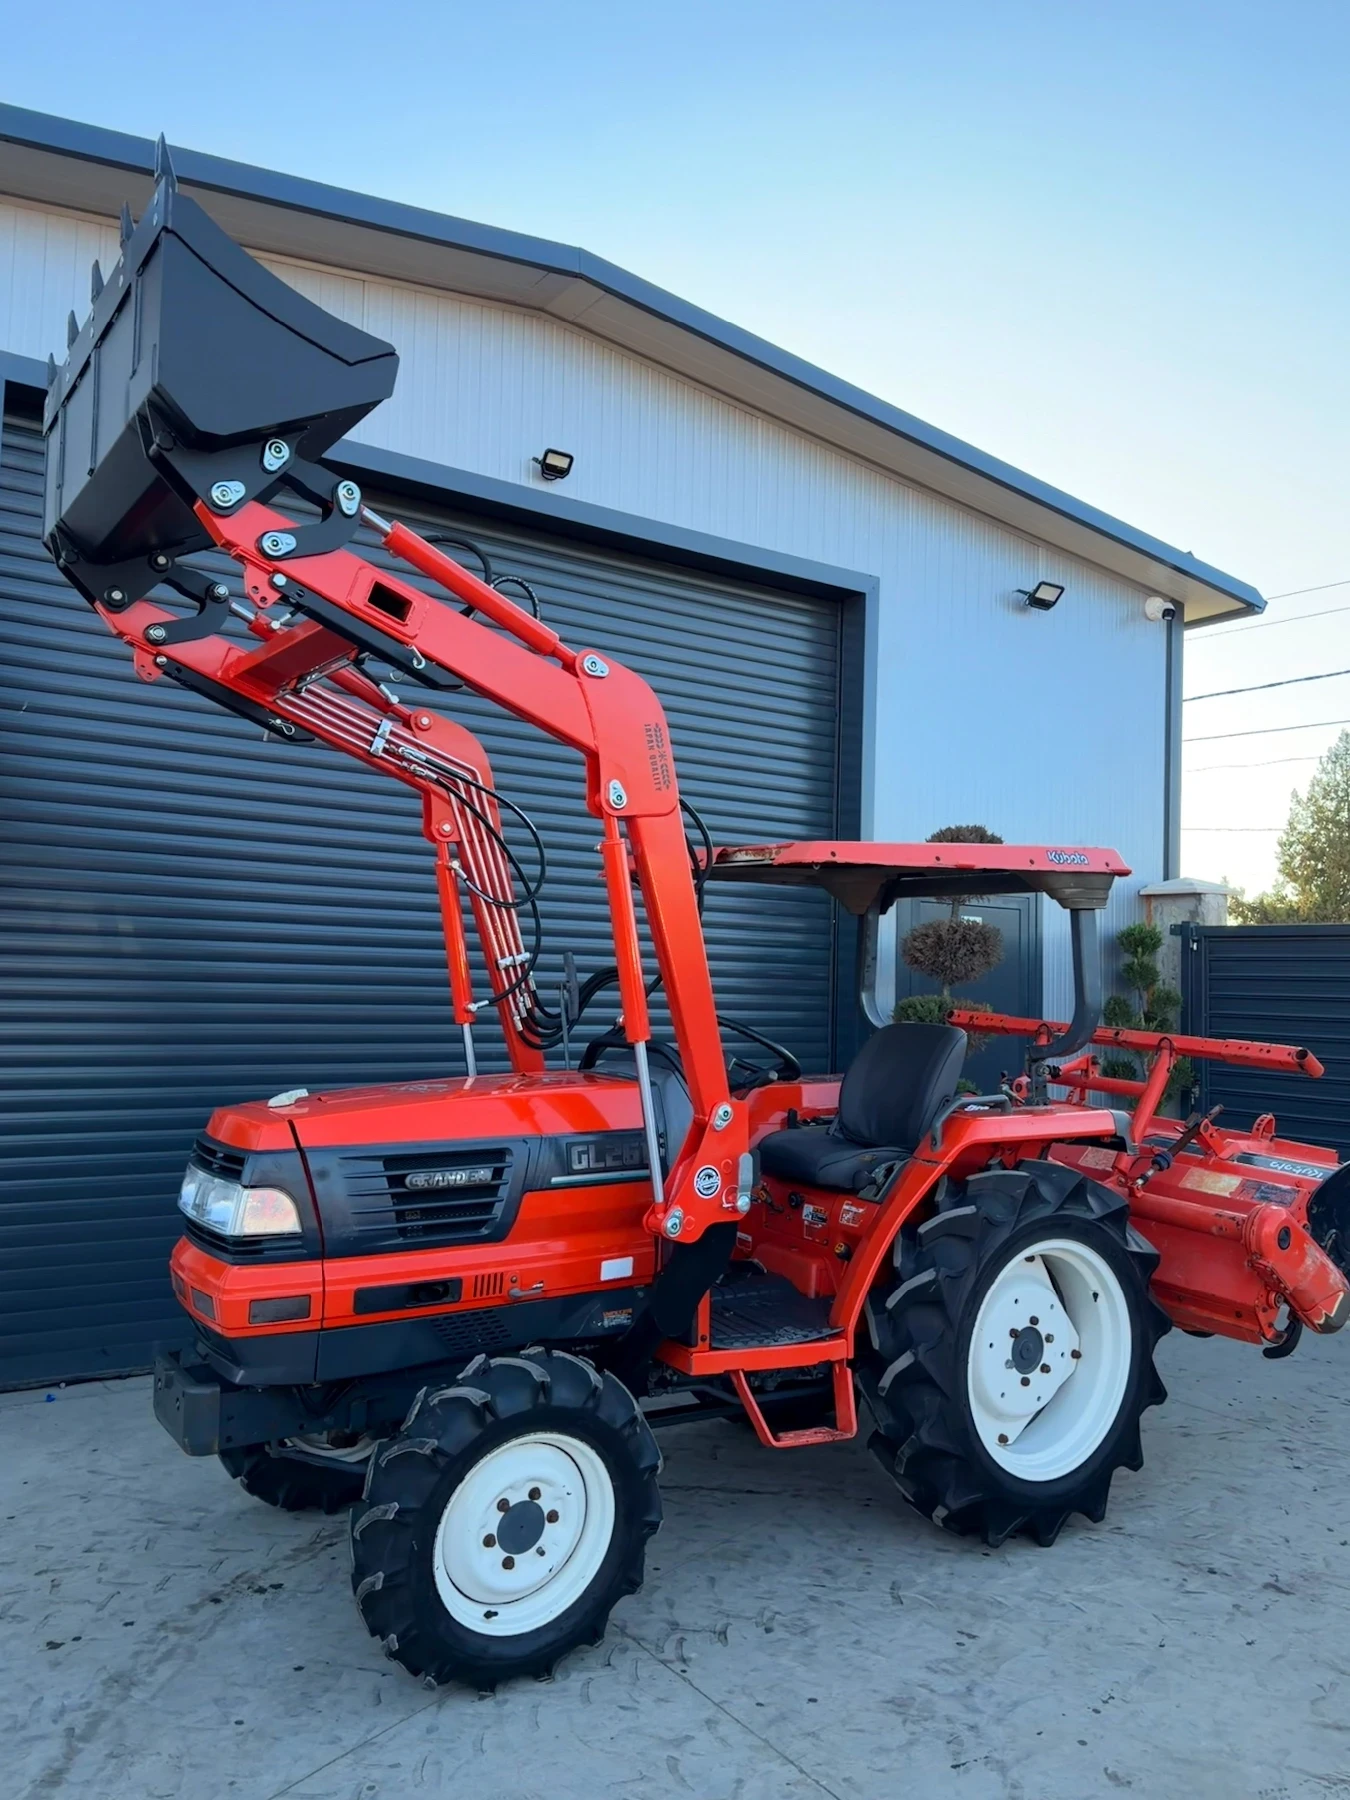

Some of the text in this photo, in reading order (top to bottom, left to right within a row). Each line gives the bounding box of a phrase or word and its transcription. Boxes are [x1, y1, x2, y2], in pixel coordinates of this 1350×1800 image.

[644, 723, 662, 791] JAPAN QUALITY
[1046, 850, 1089, 865] Kubota
